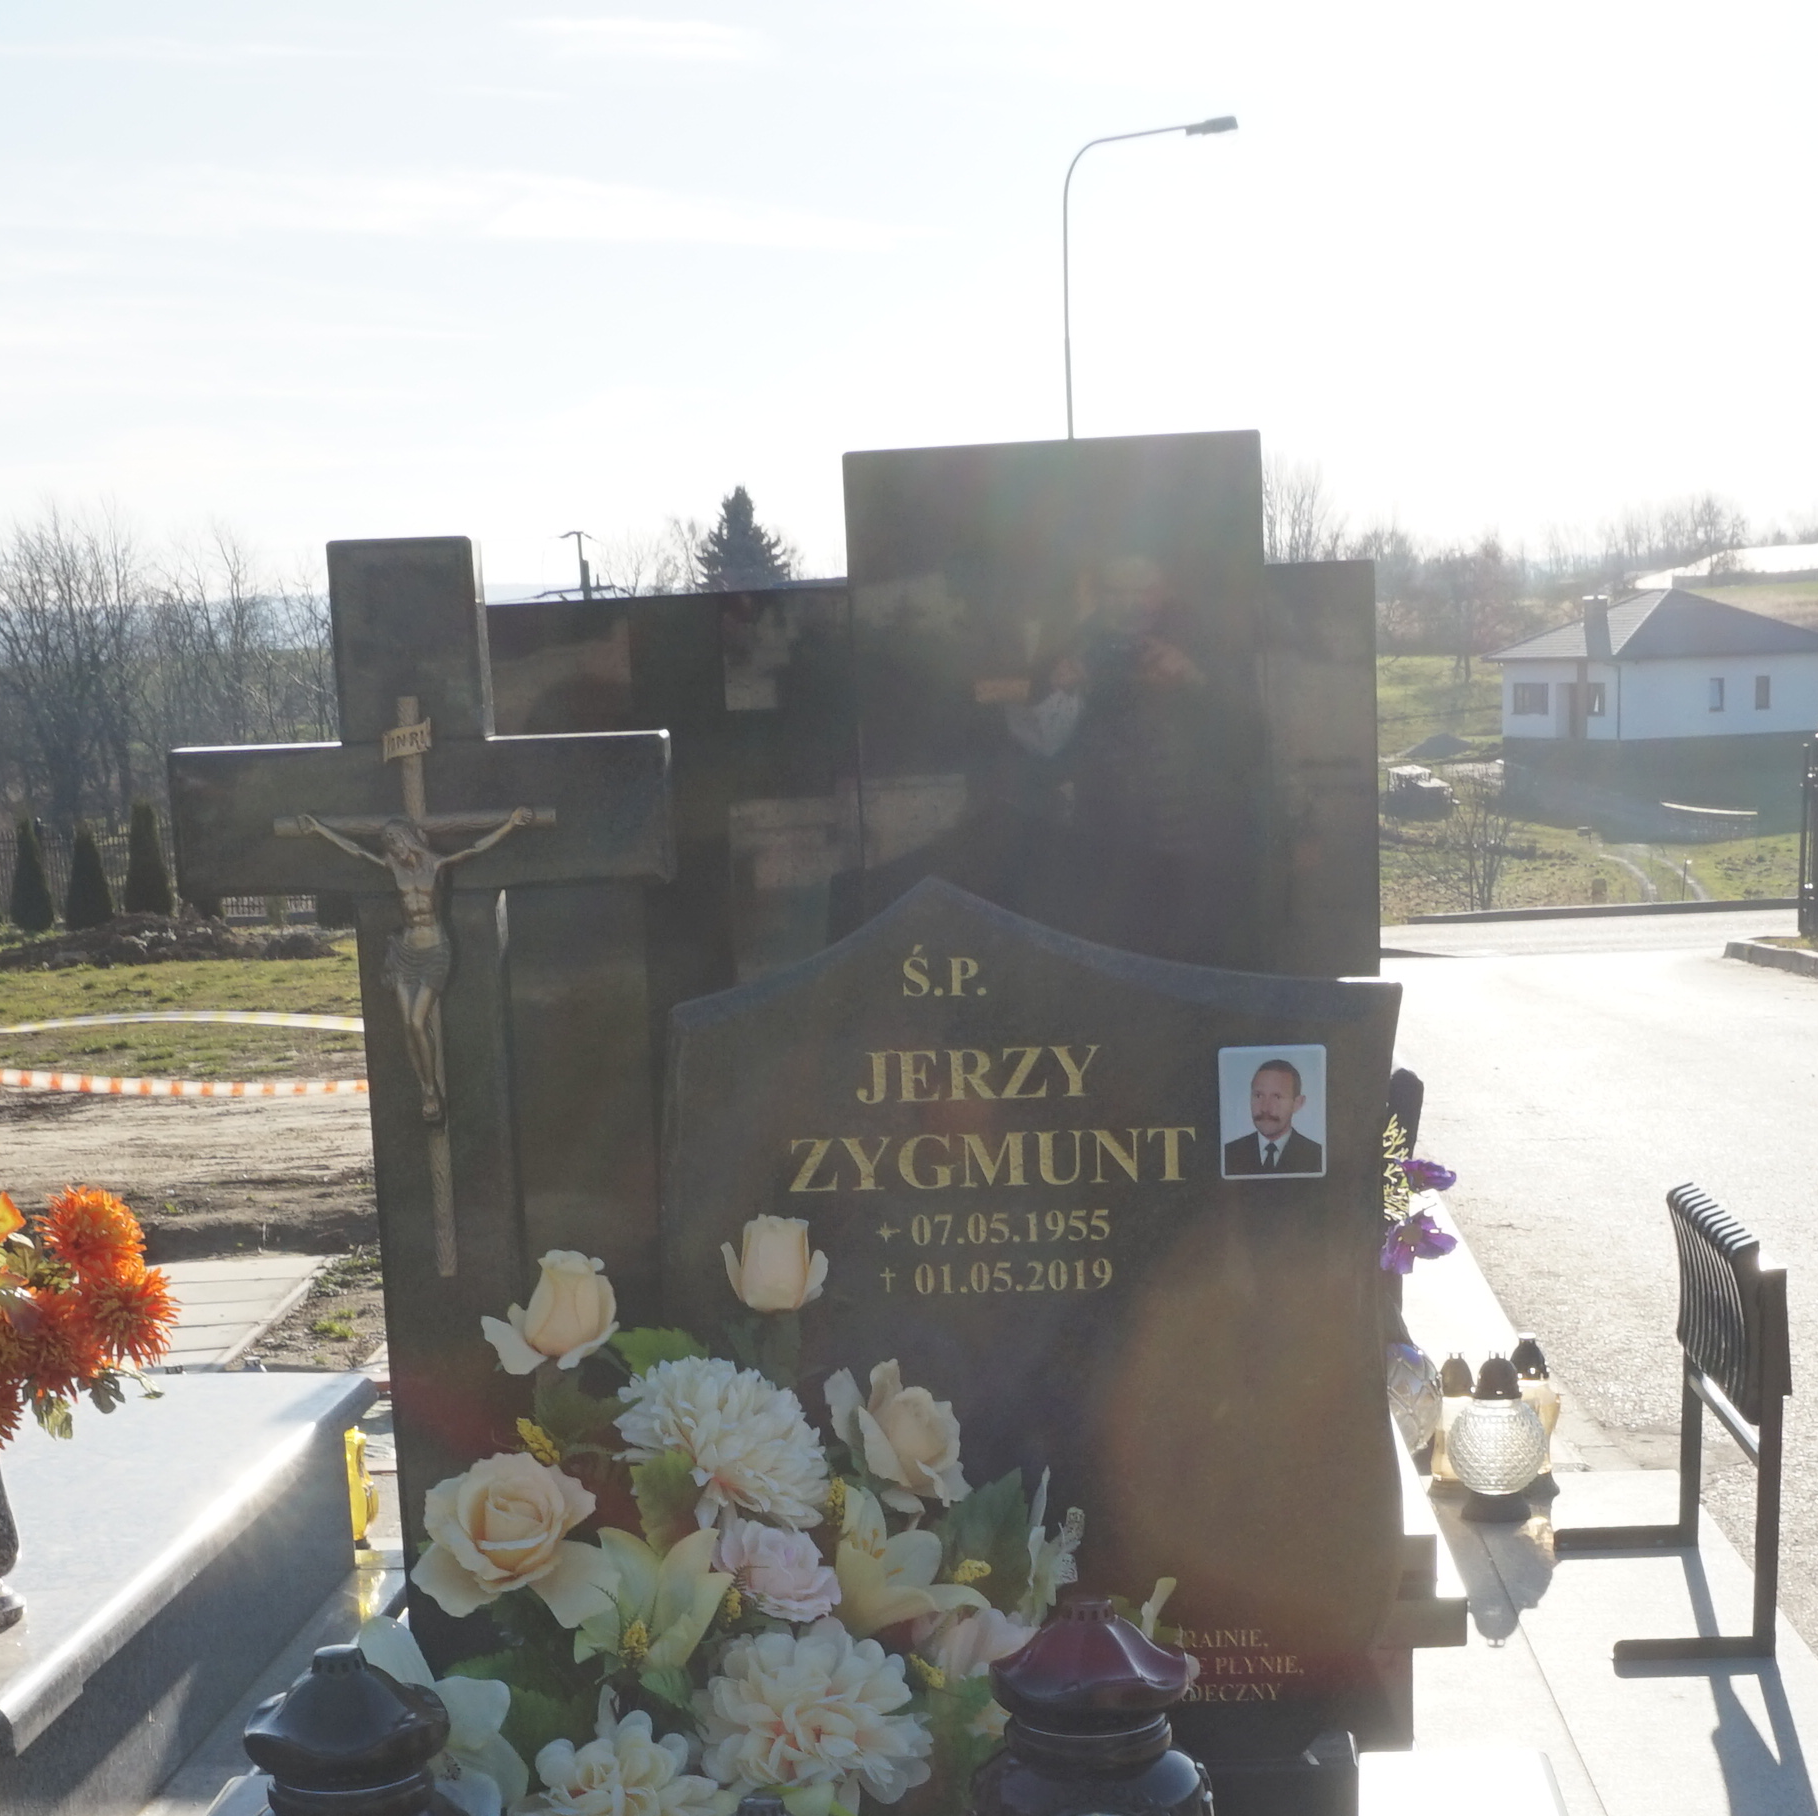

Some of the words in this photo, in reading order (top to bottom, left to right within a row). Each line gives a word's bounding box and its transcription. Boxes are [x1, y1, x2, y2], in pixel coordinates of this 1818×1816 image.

[902, 944, 988, 998] Ś.P.
[856, 1044, 1101, 1105] JERZY
[788, 1126, 1196, 1193] ZYGMUNT
[911, 1208, 1111, 1246] 07.05.1955
[914, 1257, 1113, 1295] 01.05.2019
